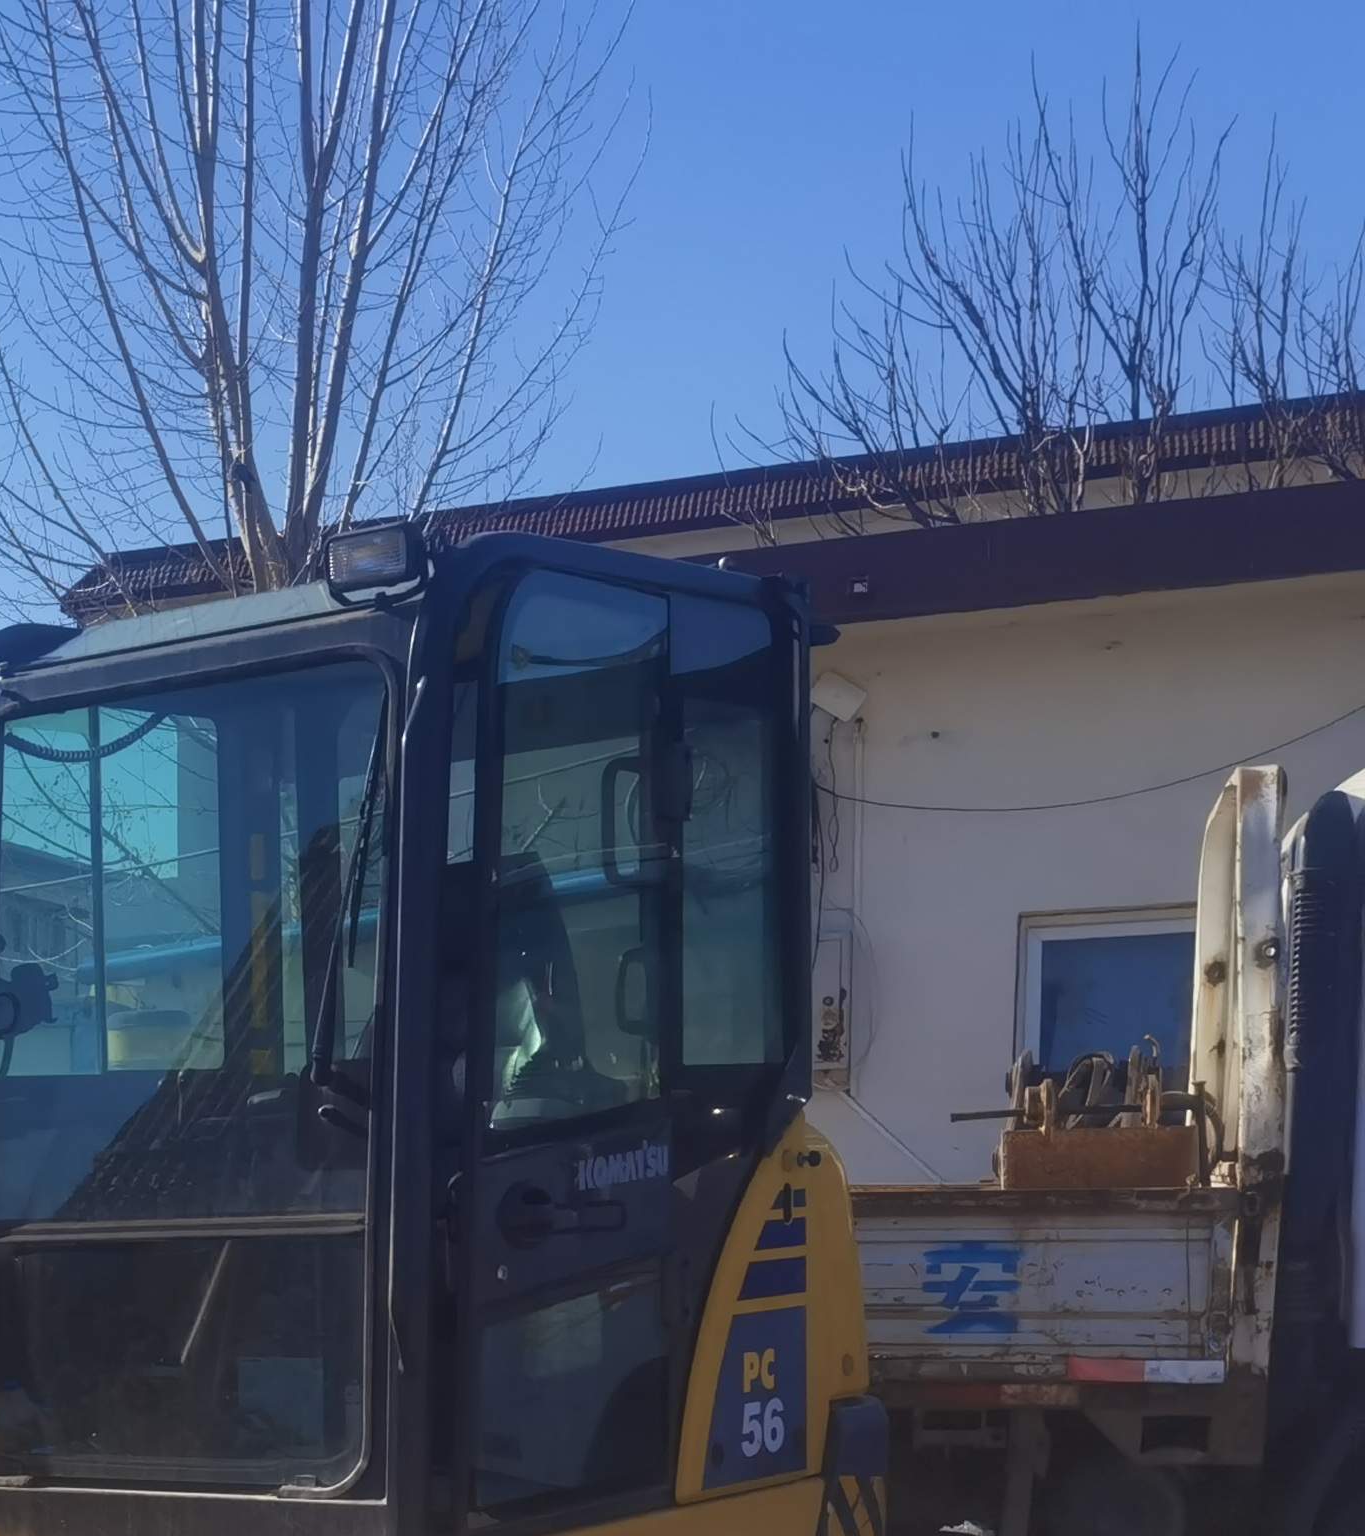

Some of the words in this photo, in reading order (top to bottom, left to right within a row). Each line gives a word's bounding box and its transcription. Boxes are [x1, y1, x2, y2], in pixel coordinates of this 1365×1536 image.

[577, 1139, 669, 1191] KOMATSU
[743, 1347, 775, 1393] PC
[740, 1397, 785, 1457] 56
